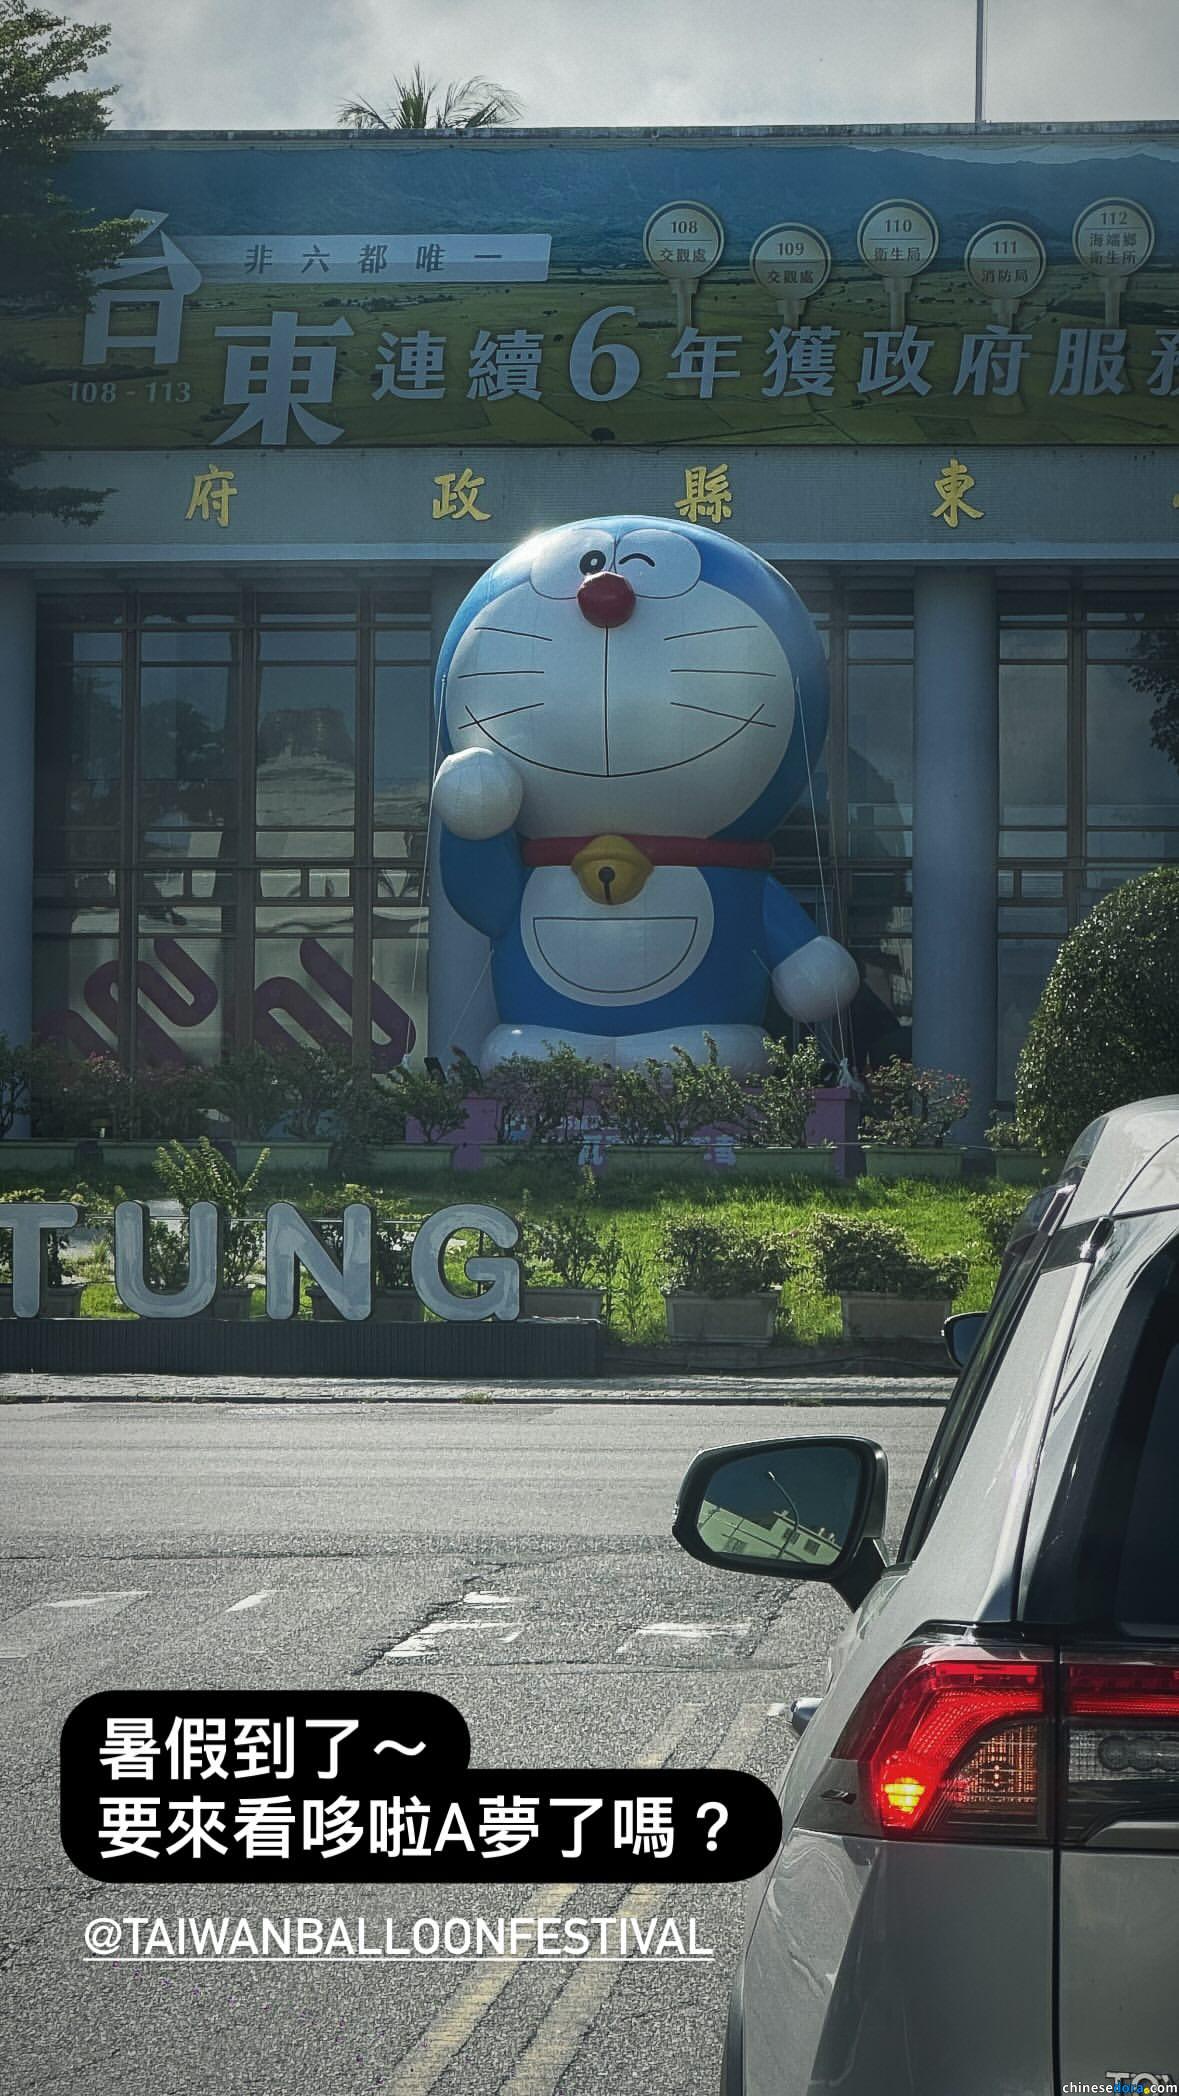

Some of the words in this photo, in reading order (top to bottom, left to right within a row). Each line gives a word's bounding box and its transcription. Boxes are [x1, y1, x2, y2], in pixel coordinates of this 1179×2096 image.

[1101, 212, 1128, 225] 112
[671, 221, 698, 234] 108
[885, 219, 912, 233] 110
[778, 243, 805, 256] 109
[993, 241, 1017, 254] 111
[244, 244, 503, 274] 非六都唯一
[660, 247, 707, 263] 交觀處
